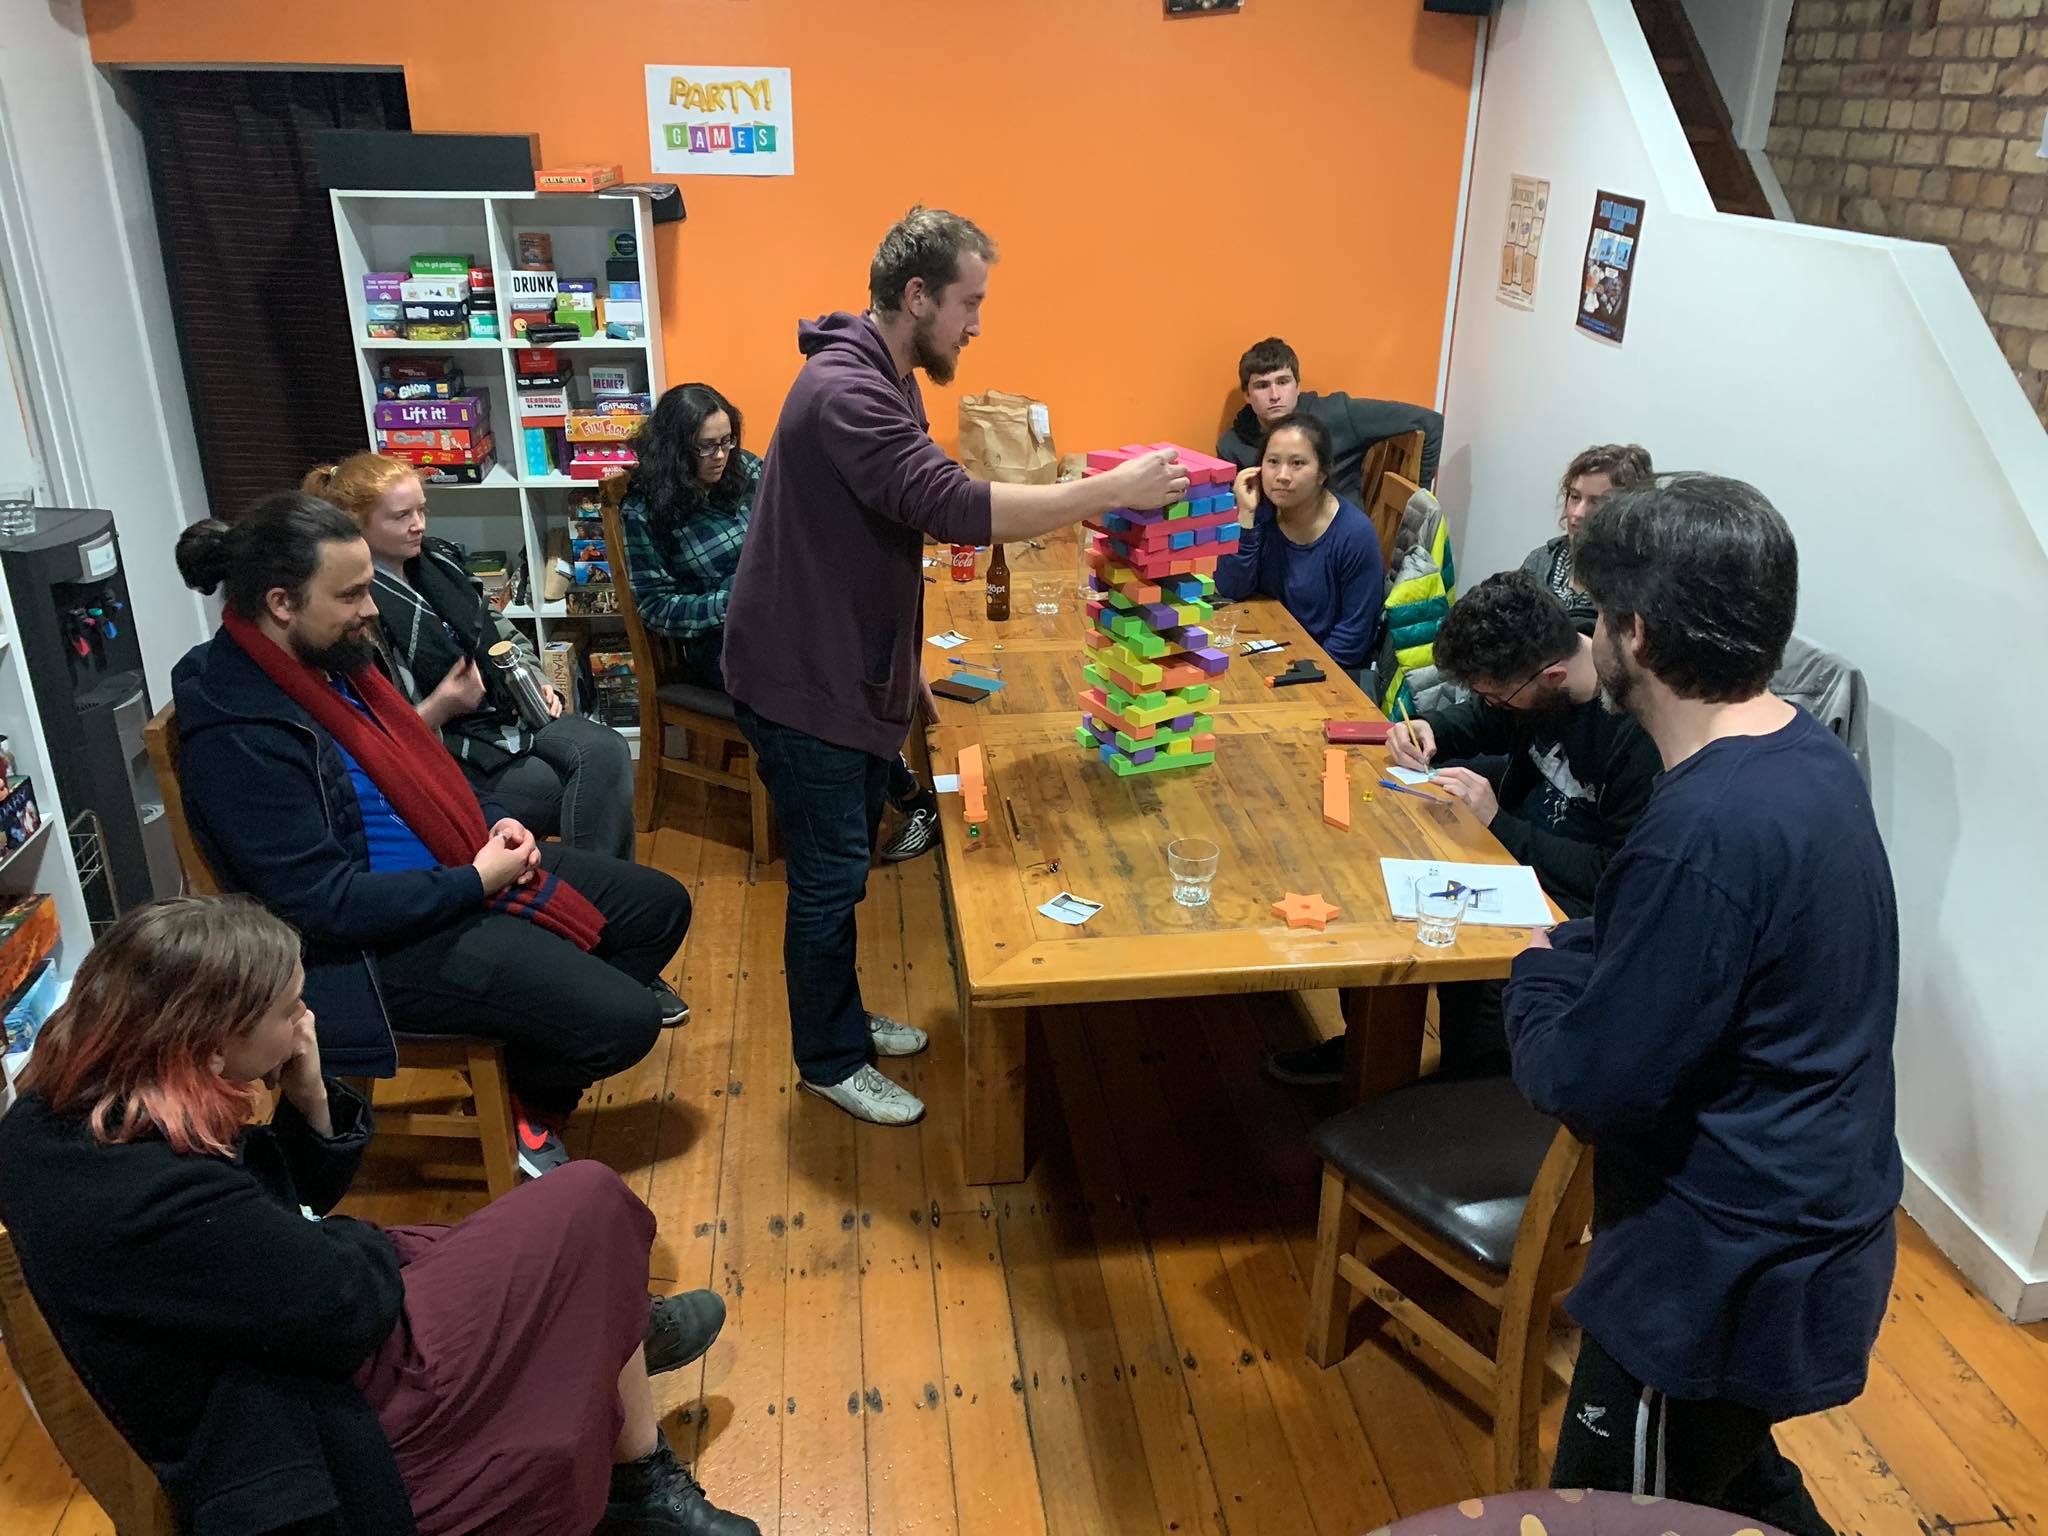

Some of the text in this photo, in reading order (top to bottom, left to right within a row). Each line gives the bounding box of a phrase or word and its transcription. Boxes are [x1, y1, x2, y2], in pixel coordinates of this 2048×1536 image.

[669, 76, 771, 114] PARTY!
[672, 127, 768, 149] GAMES
[513, 276, 555, 293] DRUNK
[433, 306, 455, 317] ROLF
[399, 384, 431, 399] GHOST
[593, 379, 624, 389] MEME?
[402, 406, 447, 424] Lift it!
